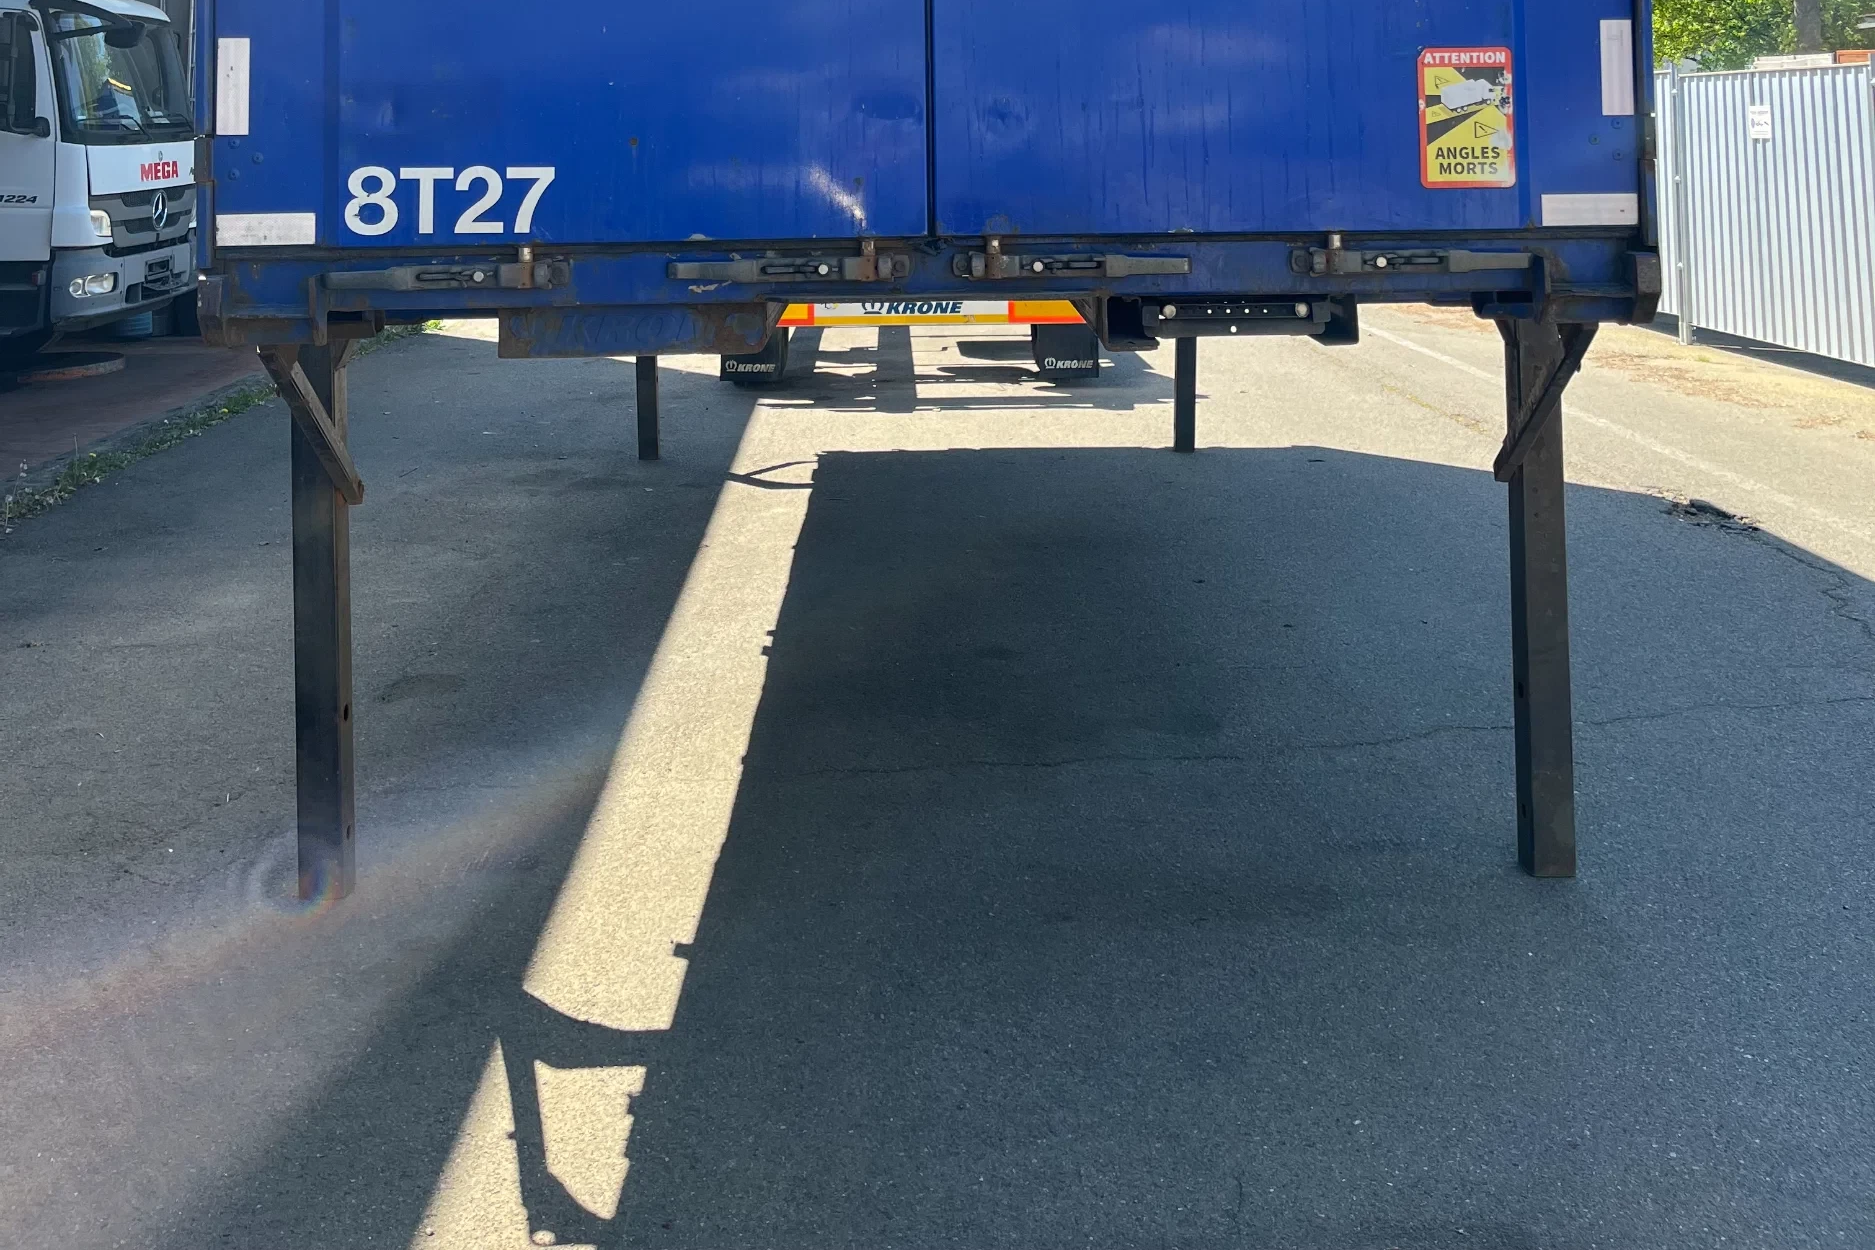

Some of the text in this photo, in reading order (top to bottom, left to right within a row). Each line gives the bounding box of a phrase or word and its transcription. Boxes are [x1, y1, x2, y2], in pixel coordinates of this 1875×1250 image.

[1424, 52, 1506, 64] ATTENTION
[1435, 146, 1500, 160] ANGLES
[140, 161, 179, 182] MEGA
[1440, 162, 1498, 175] MORTS
[344, 166, 556, 235] 8T27
[886, 301, 963, 315] KRONE
[737, 363, 776, 373] KRONE
[1056, 359, 1094, 369] KRONE
